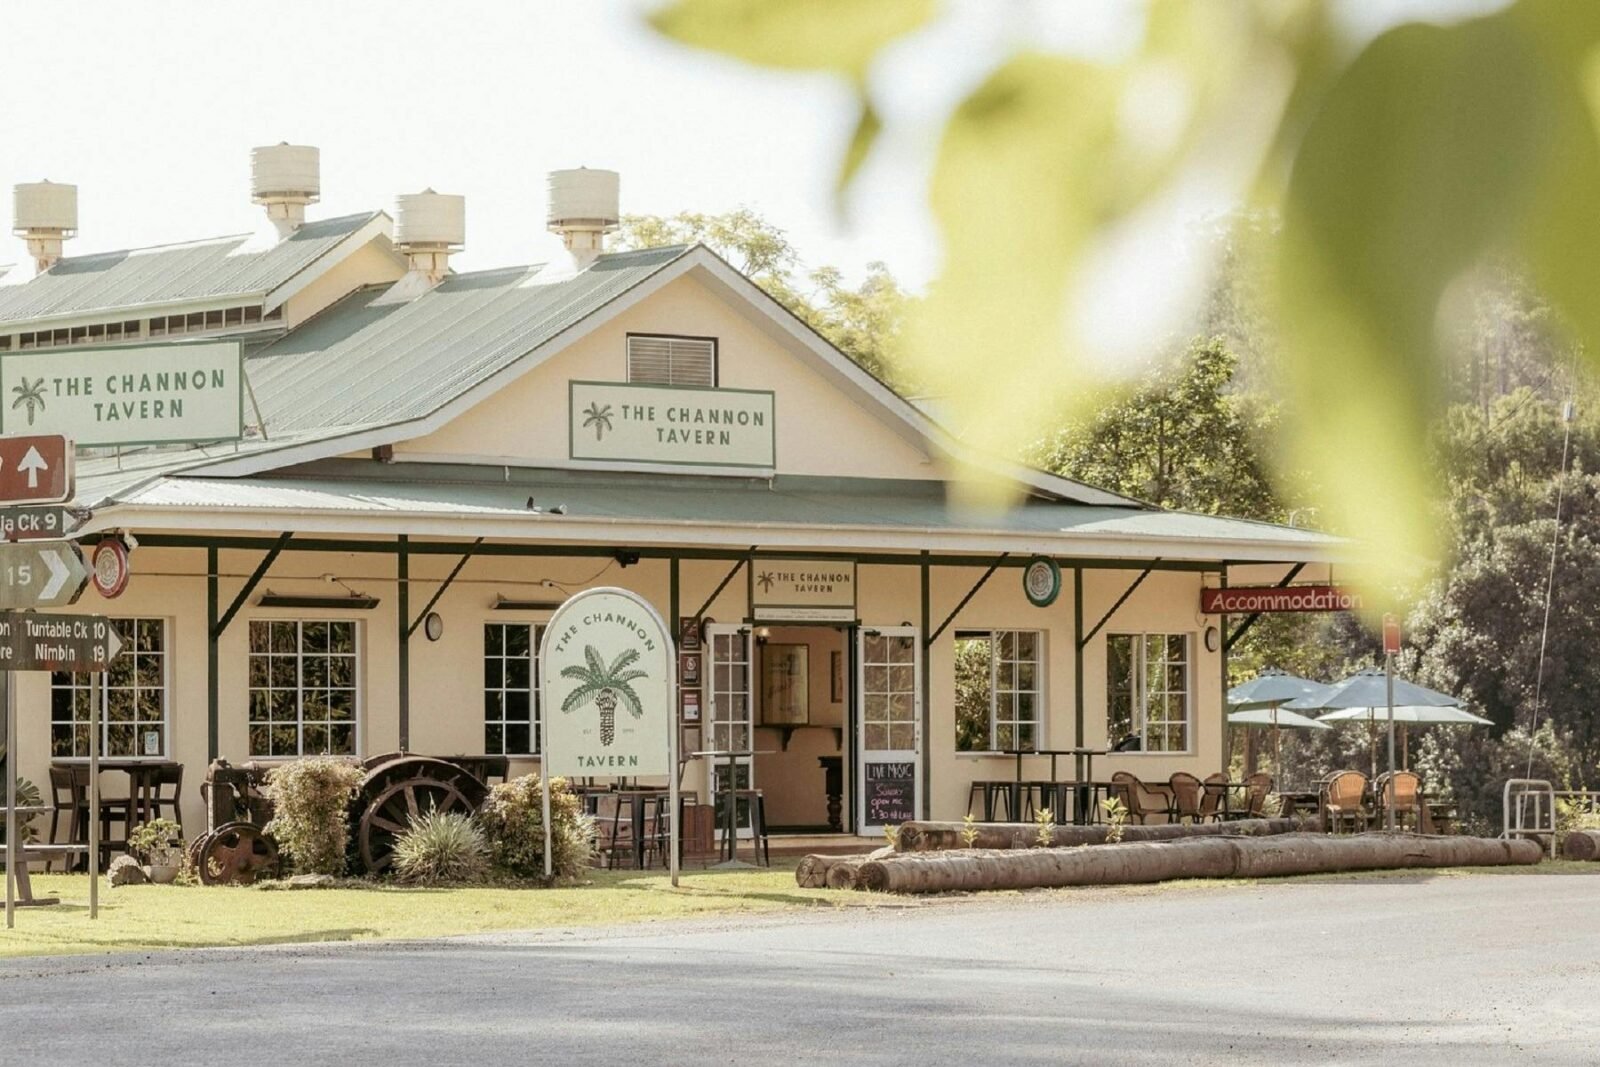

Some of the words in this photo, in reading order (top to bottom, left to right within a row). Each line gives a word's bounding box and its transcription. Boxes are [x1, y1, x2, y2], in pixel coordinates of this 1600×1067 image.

[53, 376, 93, 397] THE
[106, 368, 225, 394] CHANNON
[94, 398, 183, 422] TAVERN
[622, 404, 655, 421] THE
[667, 407, 764, 426] CHANNON
[656, 427, 730, 445] TAVERN
[18, 514, 39, 531] Ck
[44, 512, 57, 530] 9
[8, 566, 31, 586] 15
[777, 572, 795, 581] THE
[799, 573, 850, 583] CHANNON
[795, 584, 833, 593] TAVERN
[1210, 589, 1363, 610] Accommodation
[25, 620, 72, 638] Tuntable
[73, 621, 88, 639] Ck
[93, 622, 106, 640] 10
[555, 625, 578, 654] THE
[583, 612, 656, 652] CHANNON
[35, 643, 76, 661] Nimbin
[93, 645, 105, 662] 19
[577, 755, 638, 767] TAVERN
[866, 764, 885, 780] LIVE
[887, 763, 912, 779] MUSIC
